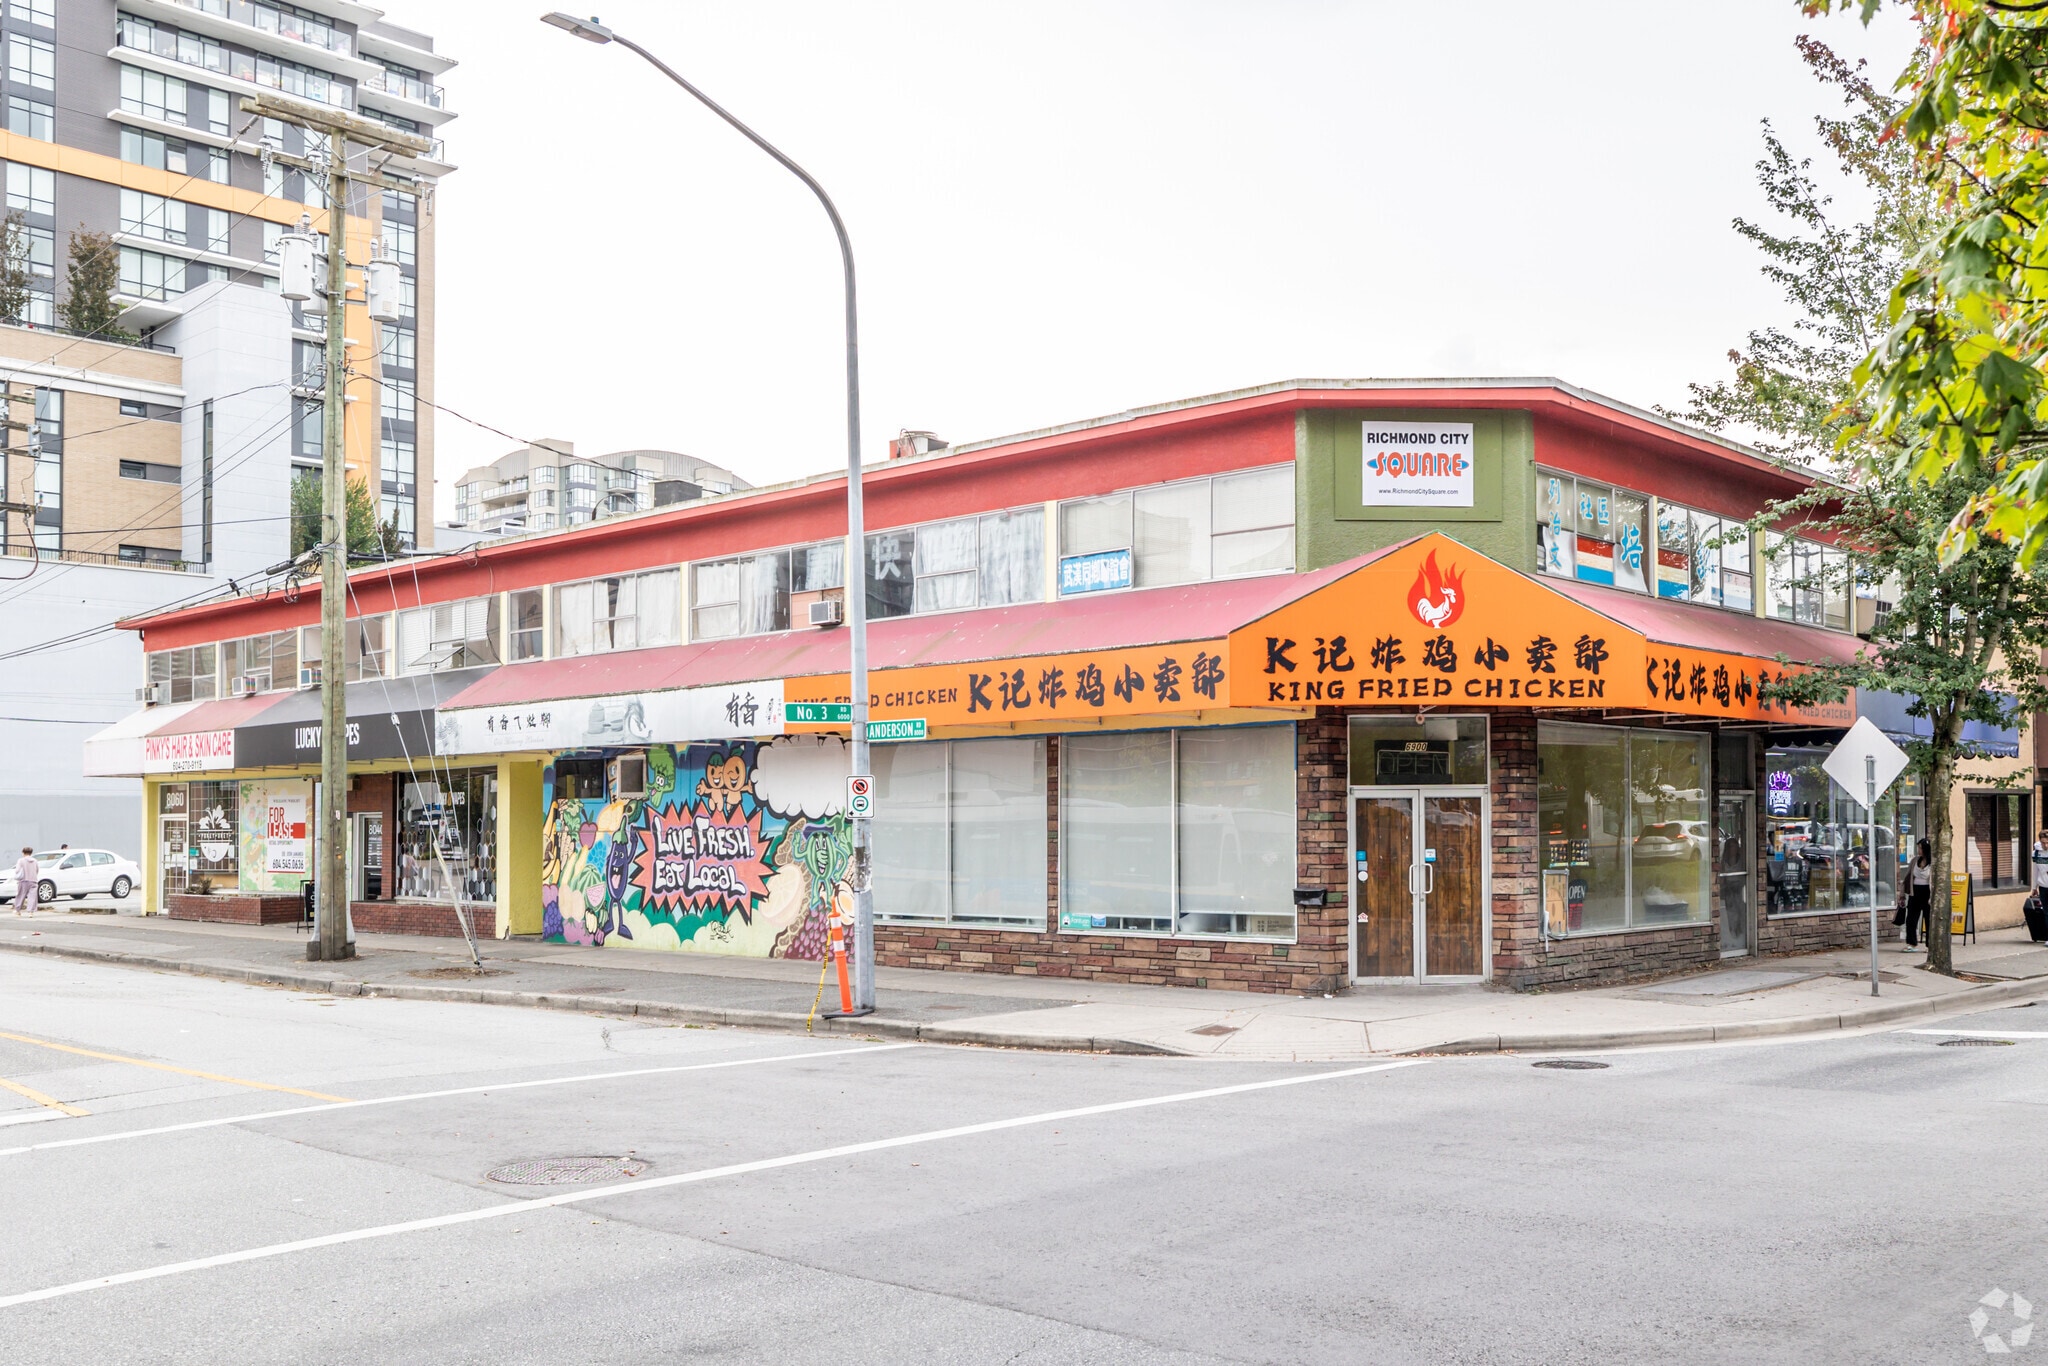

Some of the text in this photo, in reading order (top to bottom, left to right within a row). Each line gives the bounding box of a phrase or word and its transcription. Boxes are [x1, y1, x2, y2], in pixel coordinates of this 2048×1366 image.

[1367, 433, 1469, 445] RICHMOND CITY
[1376, 452, 1462, 478] SQUARE
[1378, 488, 1459, 496] www.RichmondCitySquare.com
[885, 687, 958, 708] CHICKEN
[1268, 677, 1606, 702] KING FRIED CHICKEN
[796, 706, 816, 720] No.
[821, 706, 828, 720] 3
[1821, 708, 1852, 720] CHICKEN
[295, 726, 322, 749] LUCKY
[868, 722, 914, 738] ANDERSON
[145, 731, 232, 761] PINKY'S HAIR & SKIN CARE
[1404, 742, 1428, 751] 6900
[1379, 752, 1445, 776] OPEN
[166, 792, 184, 807] 8060
[269, 806, 285, 823] FOR
[269, 822, 294, 838] LEASE
[1568, 885, 1586, 900] OPEN
